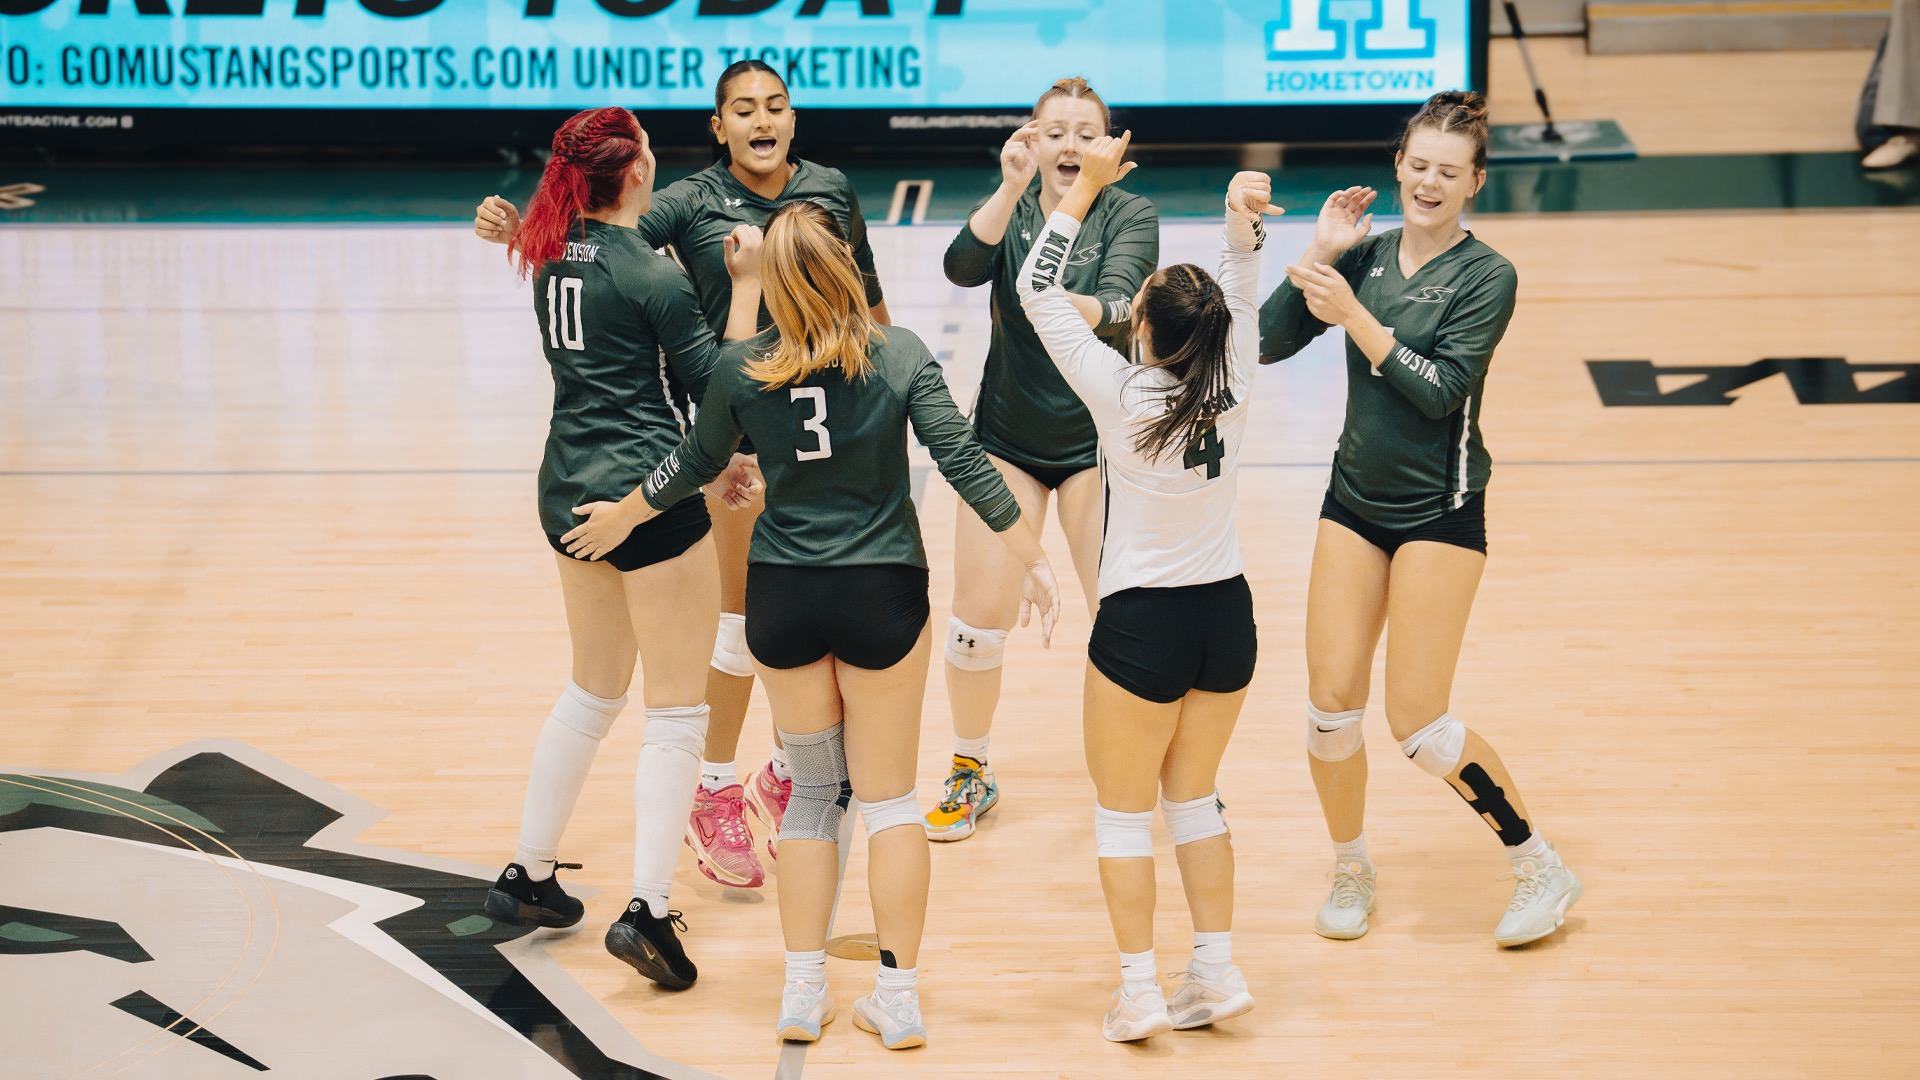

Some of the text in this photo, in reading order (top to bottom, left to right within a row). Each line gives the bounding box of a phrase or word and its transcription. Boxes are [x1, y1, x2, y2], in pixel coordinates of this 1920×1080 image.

[61, 45, 558, 89] GOMUSTANGSPORTS.COM
[574, 47, 704, 89] UNDER
[1265, 70, 1435, 92] HOMETOWN
[546, 275, 585, 351] 10
[790, 386, 833, 462] 3
[1183, 420, 1225, 480] 4
